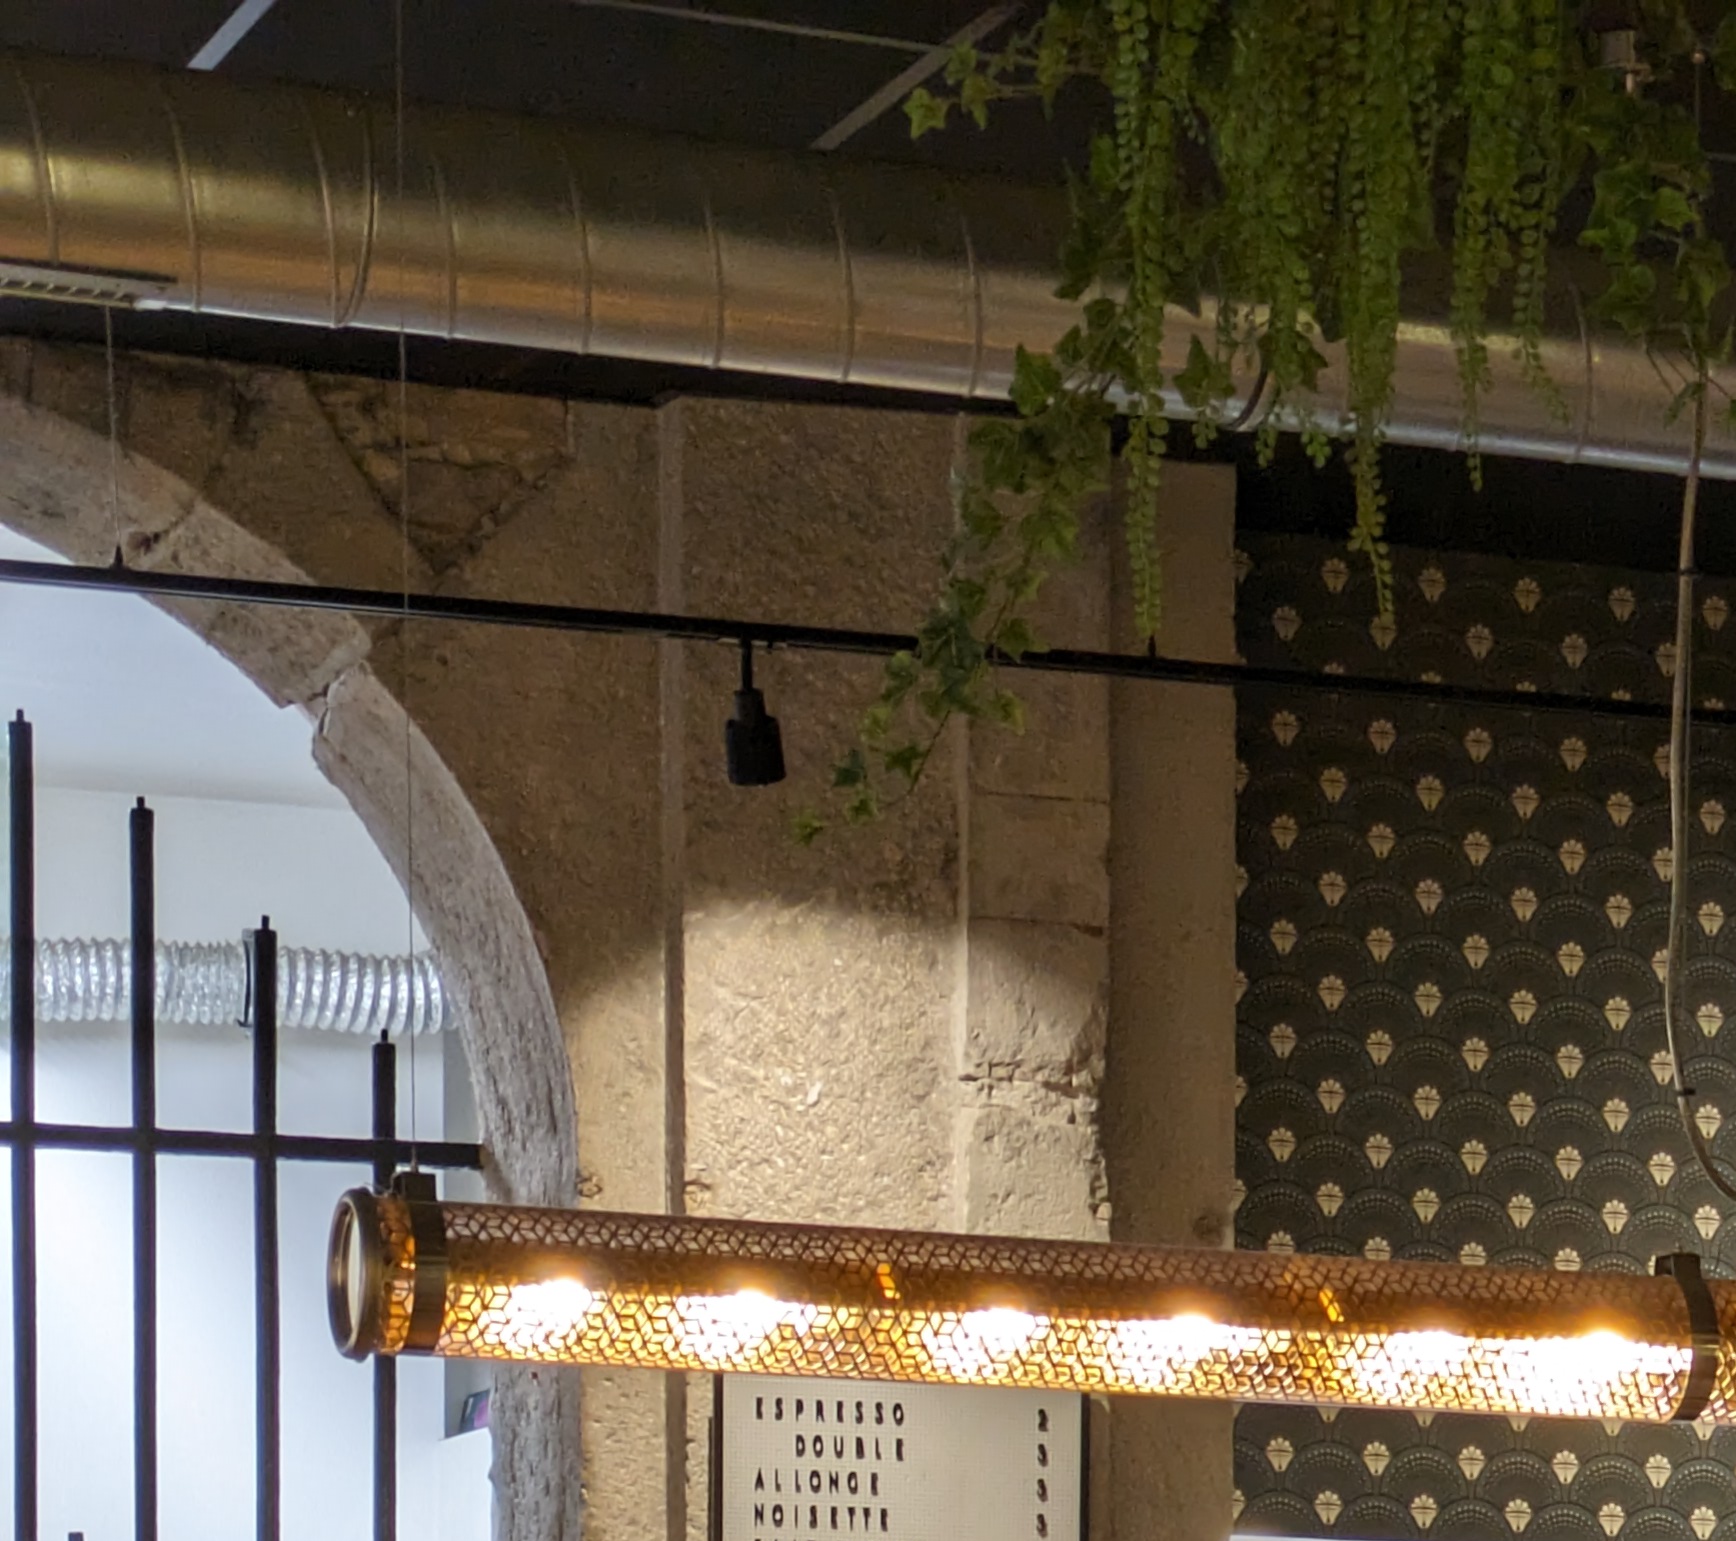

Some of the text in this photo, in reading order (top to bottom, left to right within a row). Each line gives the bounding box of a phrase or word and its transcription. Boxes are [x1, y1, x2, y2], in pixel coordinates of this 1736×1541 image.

[755, 1396, 1049, 1432] ESPRESSO 2
[795, 1433, 1049, 1467] DOUBLE 3
[1036, 1477, 1049, 1502] 3
[753, 1502, 1049, 1538] NOISETTE 3
